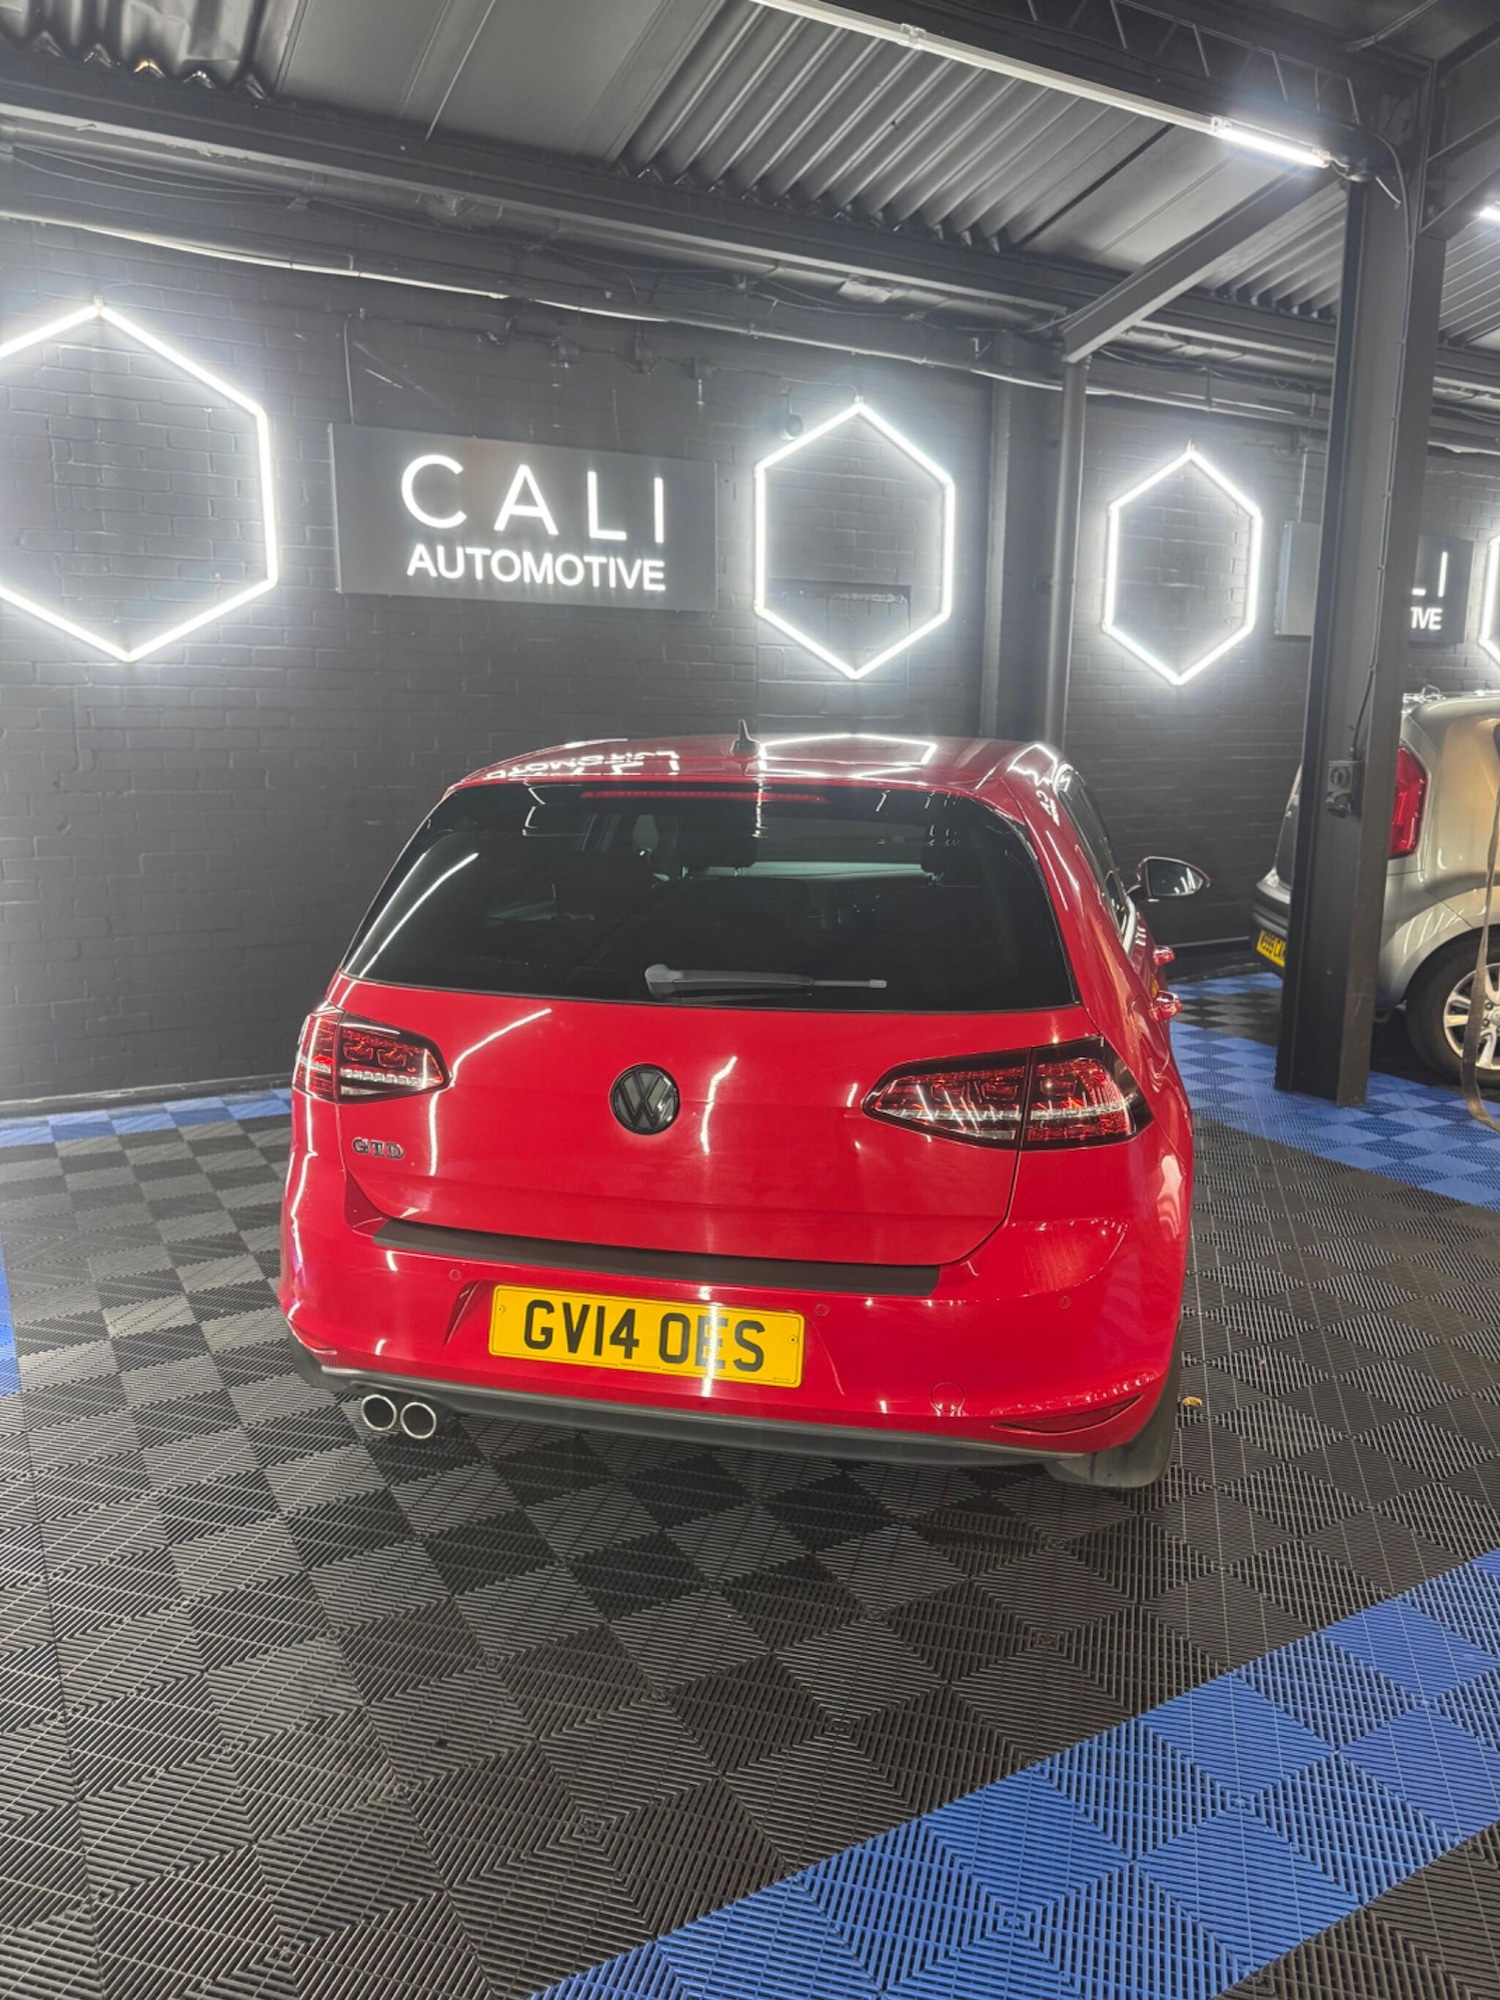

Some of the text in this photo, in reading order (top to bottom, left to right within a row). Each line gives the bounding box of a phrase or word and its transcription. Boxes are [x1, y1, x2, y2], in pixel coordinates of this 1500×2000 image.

[401, 454, 665, 544] CALI
[407, 544, 666, 592] AUTOMOTIVE
[352, 1136, 404, 1160] GTD
[523, 1299, 766, 1373] GV14 OES
